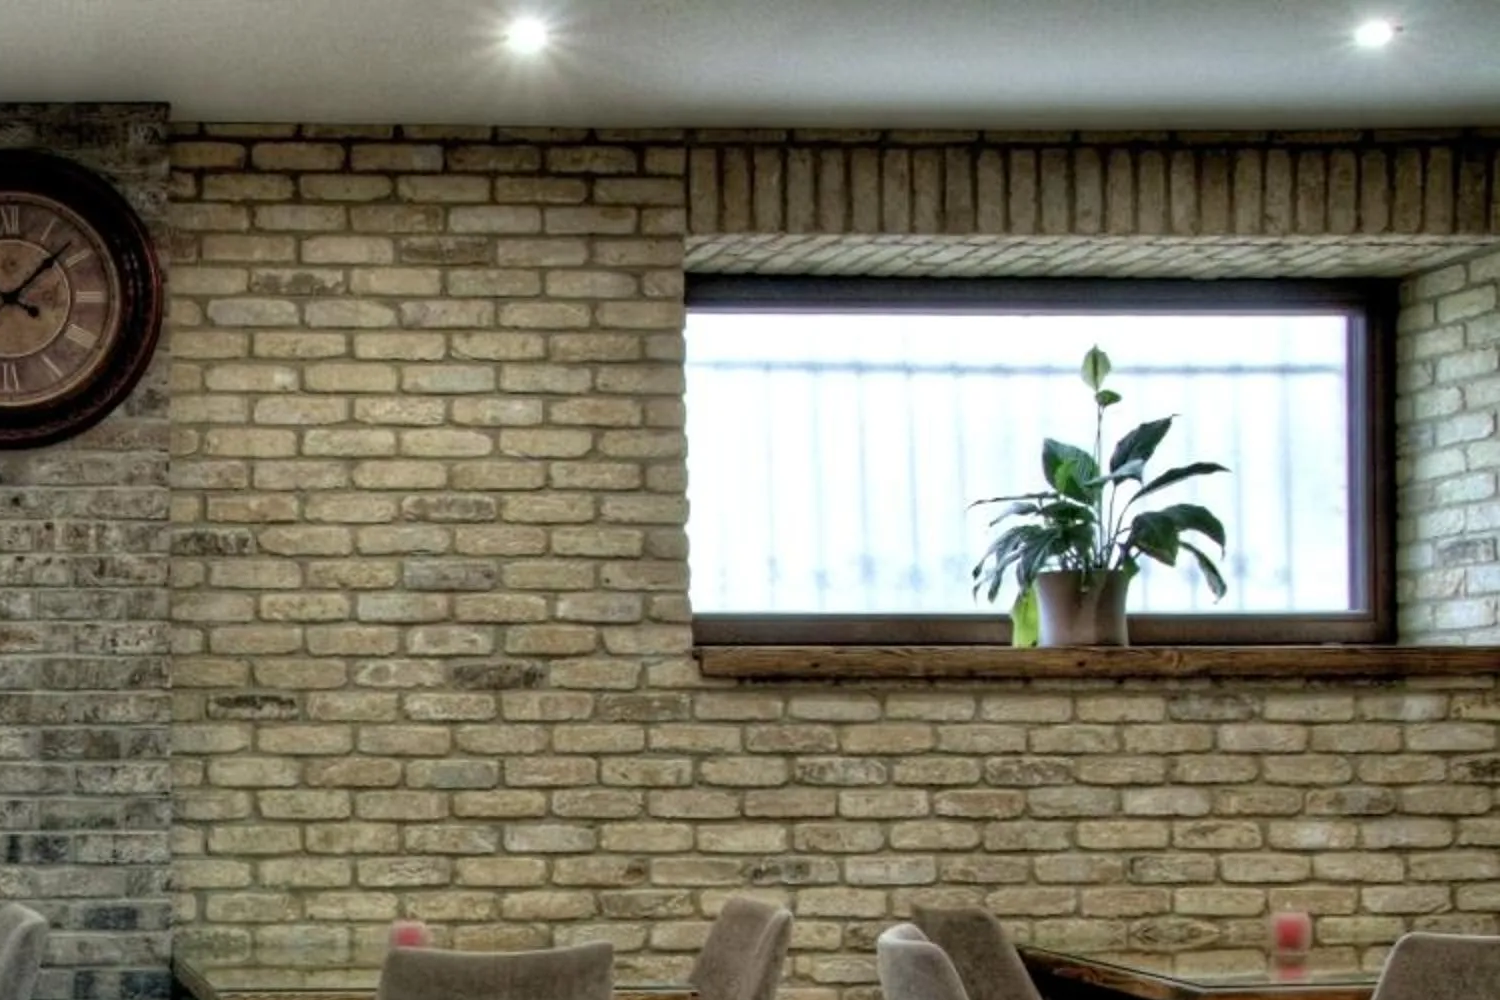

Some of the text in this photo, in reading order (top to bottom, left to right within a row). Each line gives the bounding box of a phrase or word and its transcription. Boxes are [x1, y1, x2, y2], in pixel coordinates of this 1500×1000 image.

[0, 205, 20, 235] XII
[40, 217, 61, 243] I
[75, 291, 104, 304] III
